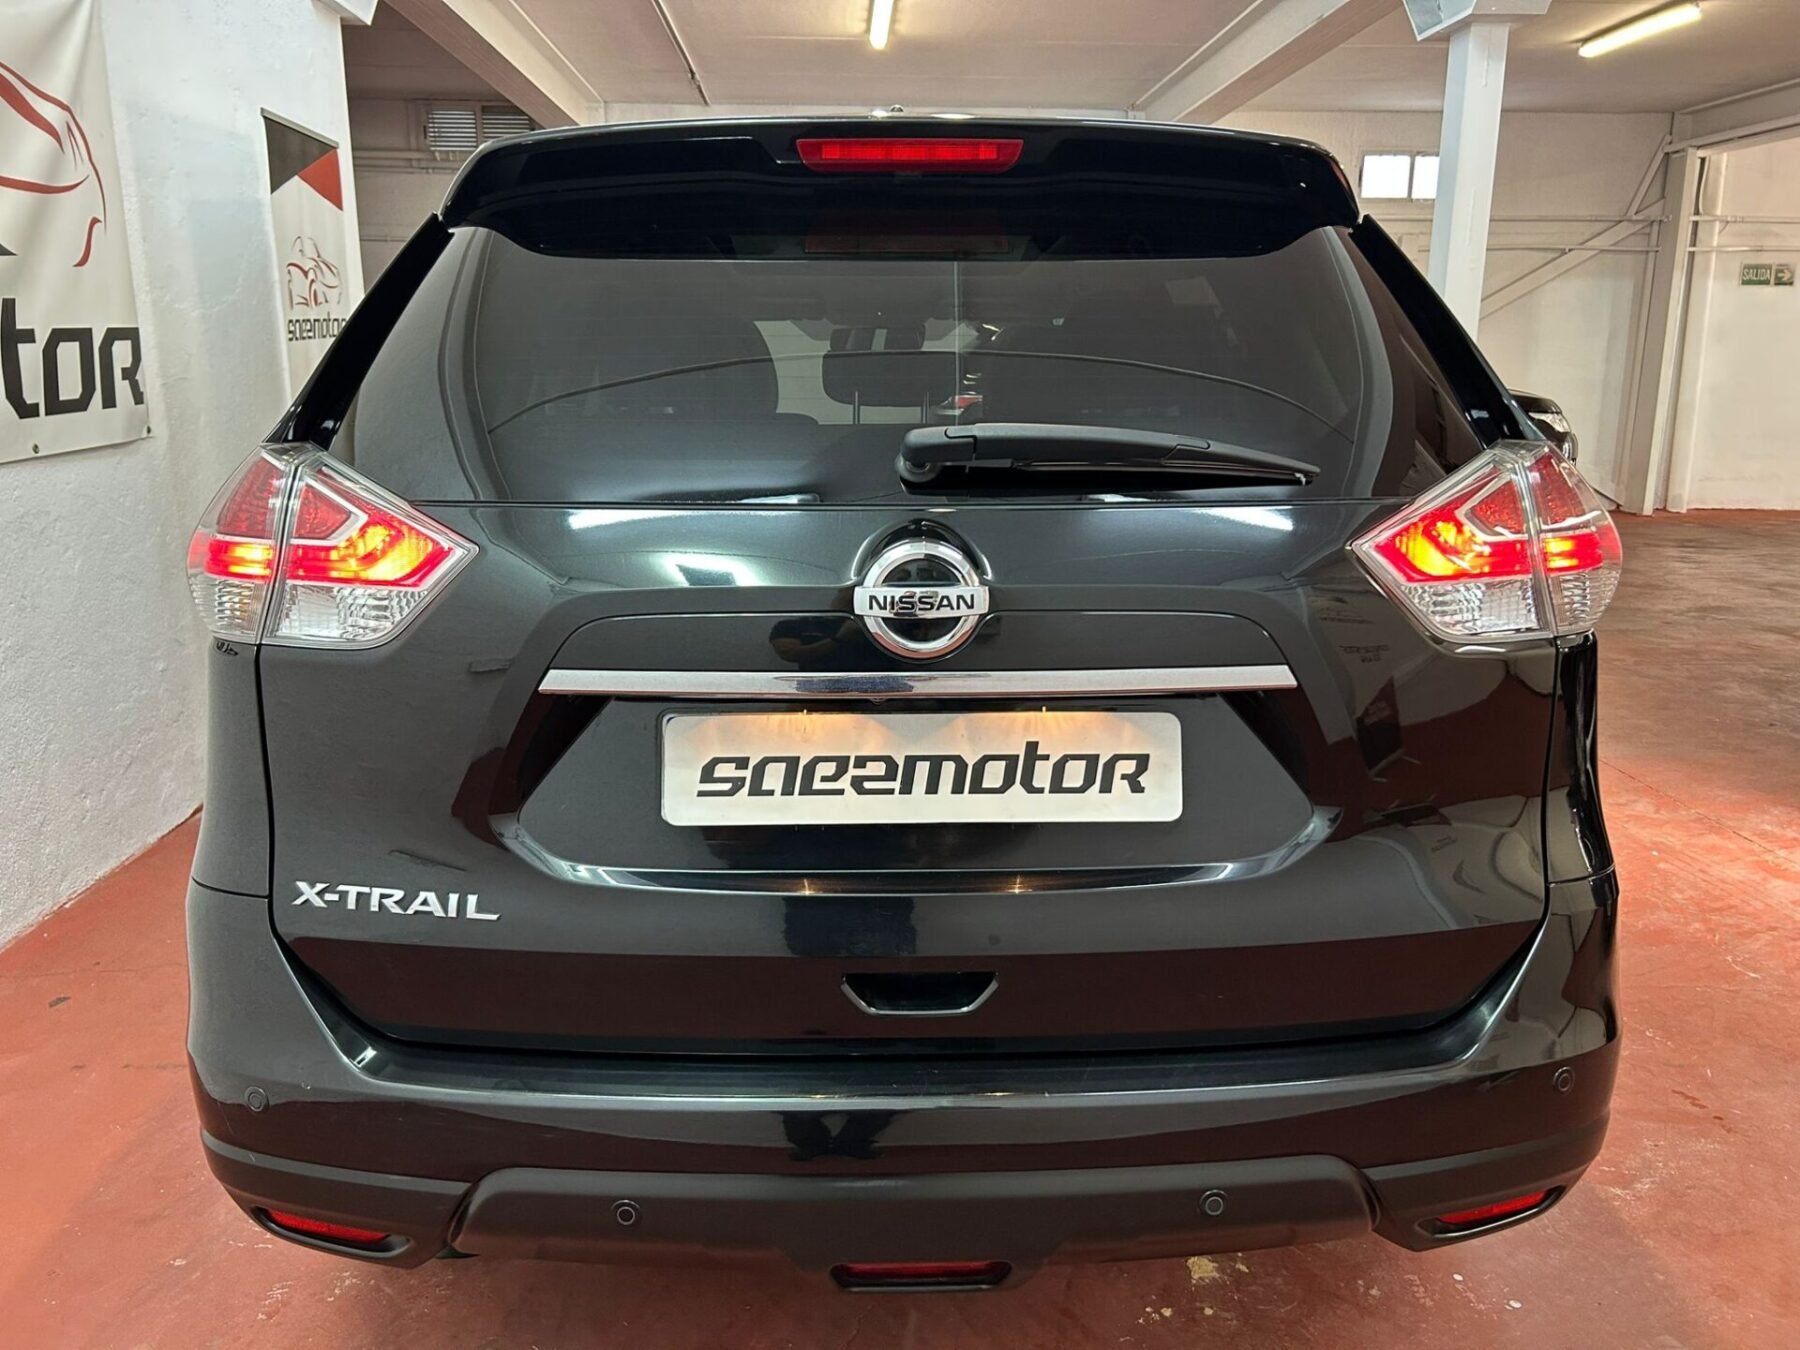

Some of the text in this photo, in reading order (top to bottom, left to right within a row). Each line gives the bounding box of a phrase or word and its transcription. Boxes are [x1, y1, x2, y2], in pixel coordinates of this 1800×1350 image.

[1742, 268, 1771, 281] SALIDA
[868, 594, 975, 611] NISSAN
[291, 881, 501, 921] X-TRAIL
